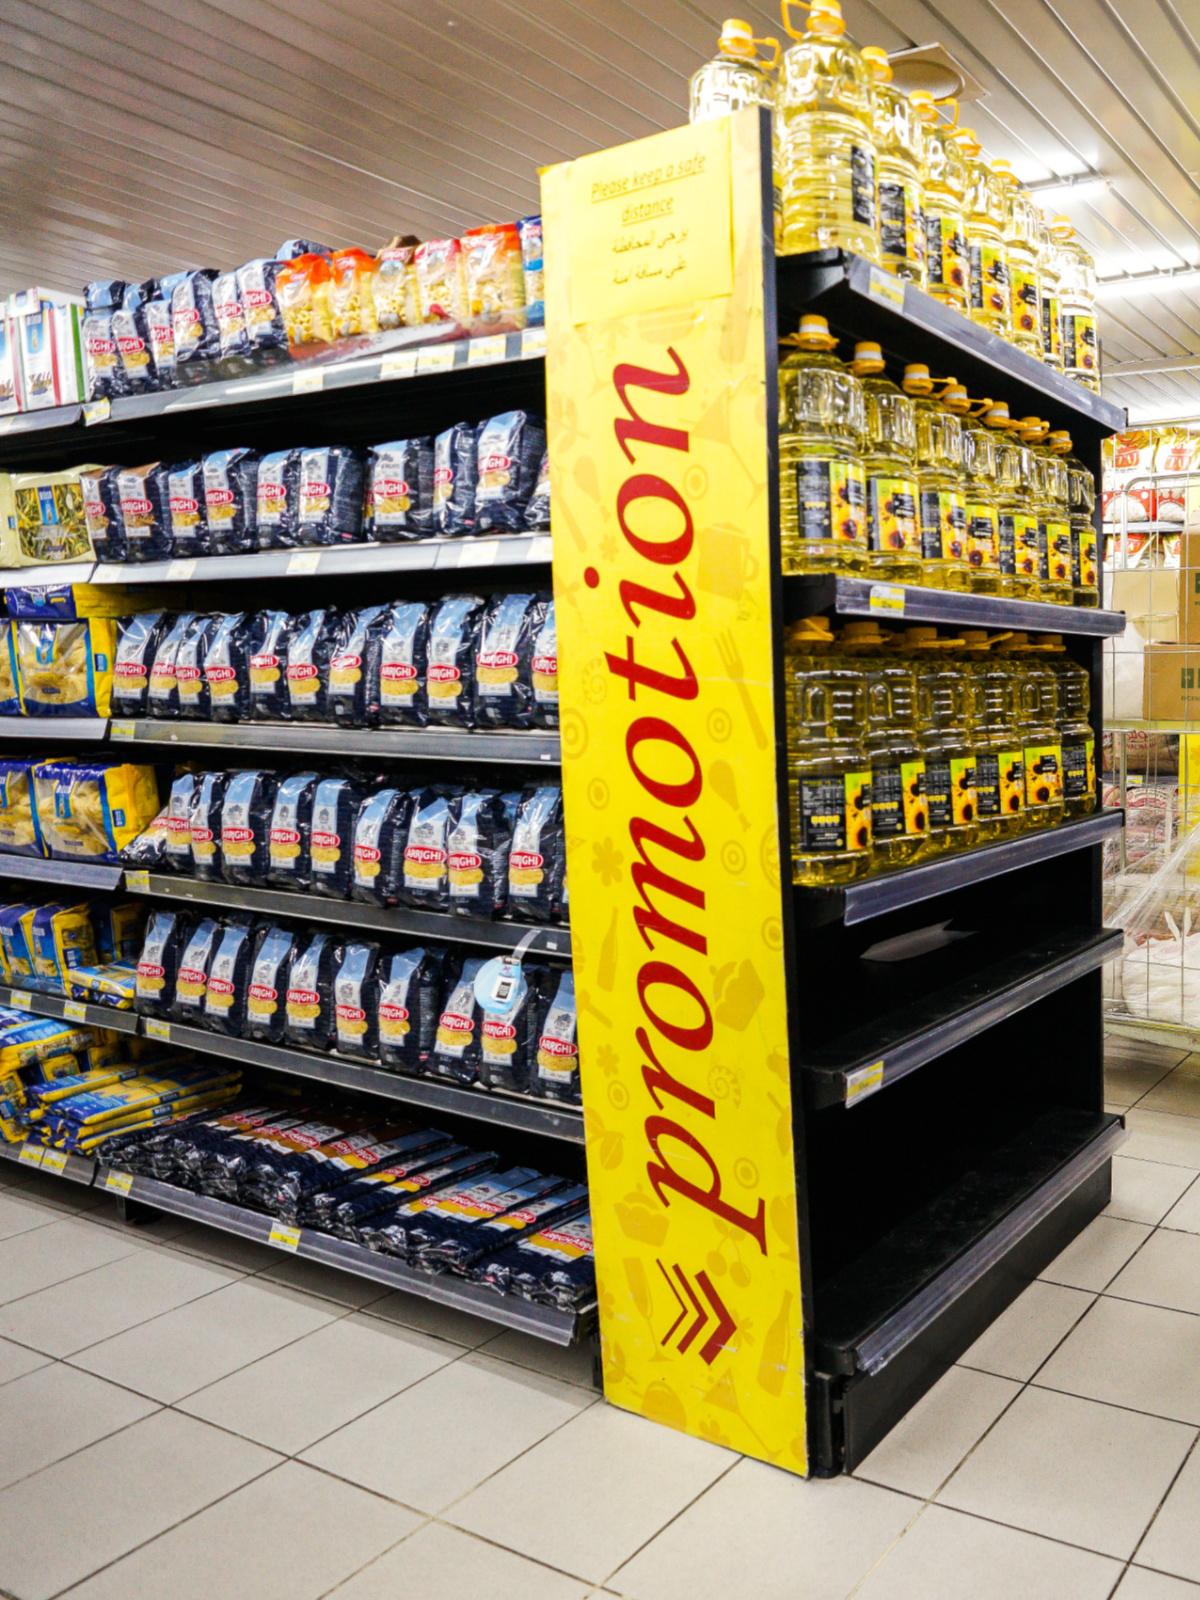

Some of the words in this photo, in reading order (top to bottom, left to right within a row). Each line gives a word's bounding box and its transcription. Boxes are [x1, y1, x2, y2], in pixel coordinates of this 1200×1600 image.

[591, 176, 628, 199] Please
[633, 168, 661, 187] keep
[678, 153, 706, 175] safe
[621, 197, 674, 222] distance
[583, 345, 768, 1257] promotion
[406, 848, 442, 863] ARRIGHI
[541, 1039, 573, 1055] ARRIGHI
